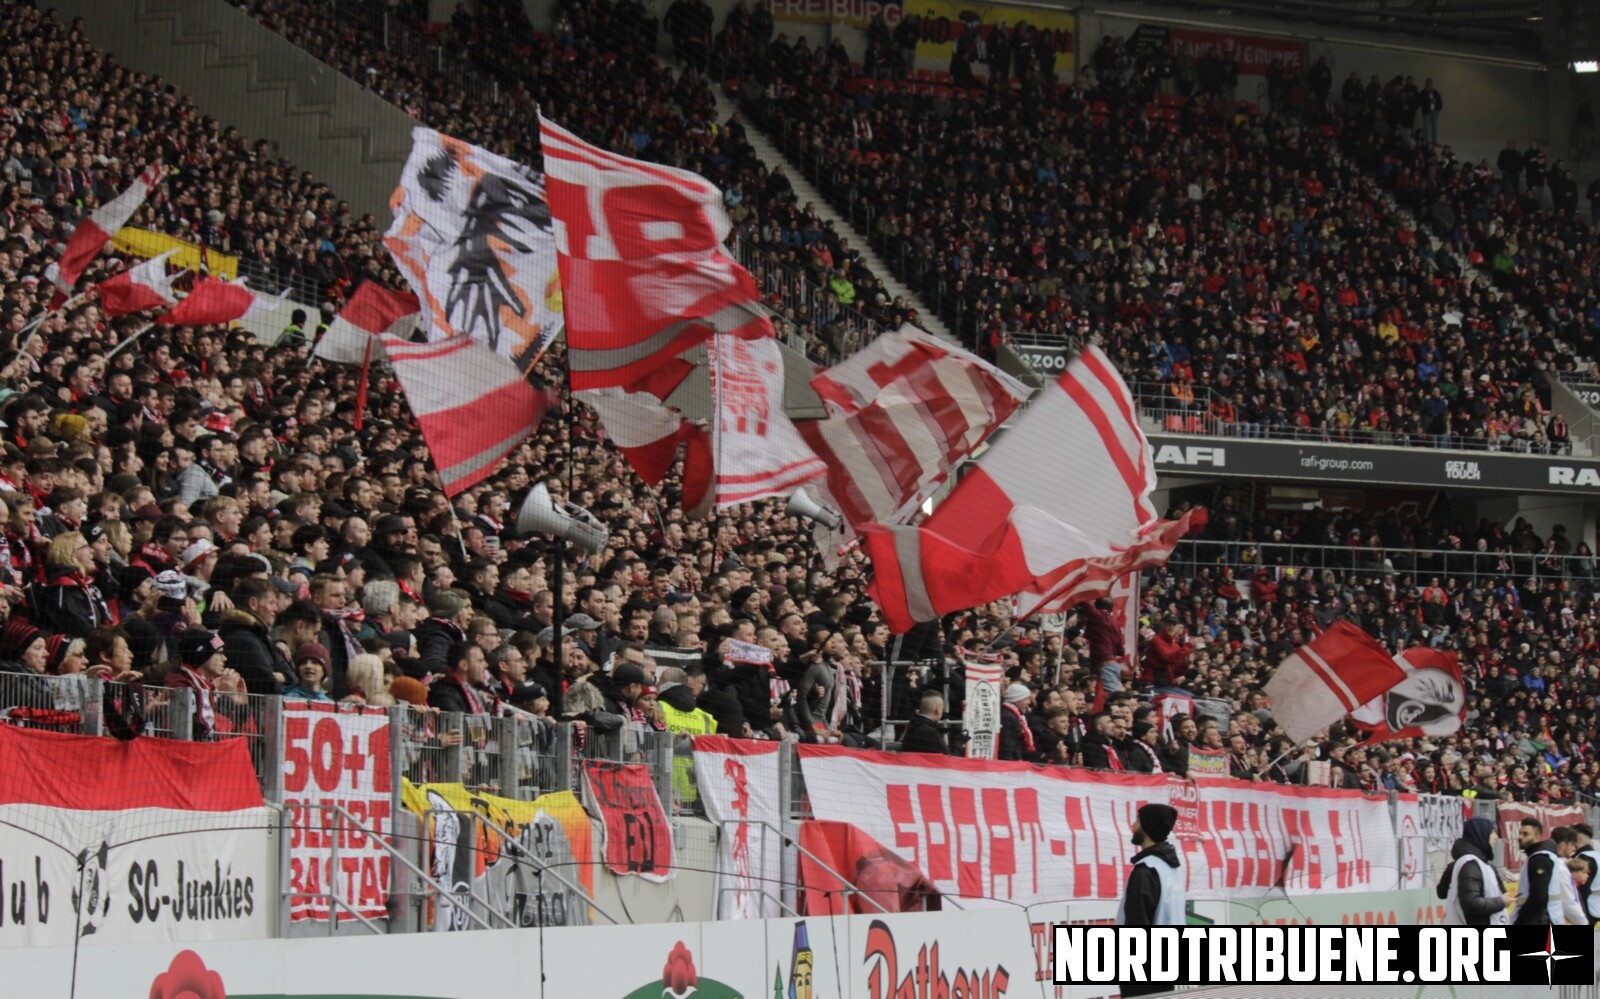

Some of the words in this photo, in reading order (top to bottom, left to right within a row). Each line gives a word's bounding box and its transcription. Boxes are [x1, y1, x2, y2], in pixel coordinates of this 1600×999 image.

[1300, 455, 1373, 471] rafi-group.com
[1445, 460, 1464, 472] GET
[1466, 462, 1478, 472] IN
[1446, 470, 1481, 480] TOUCH
[1548, 466, 1600, 486] RA
[284, 716, 392, 793] 50+1
[886, 783, 1147, 899] SPORT-CLU
[127, 858, 254, 924] SC-Junkies
